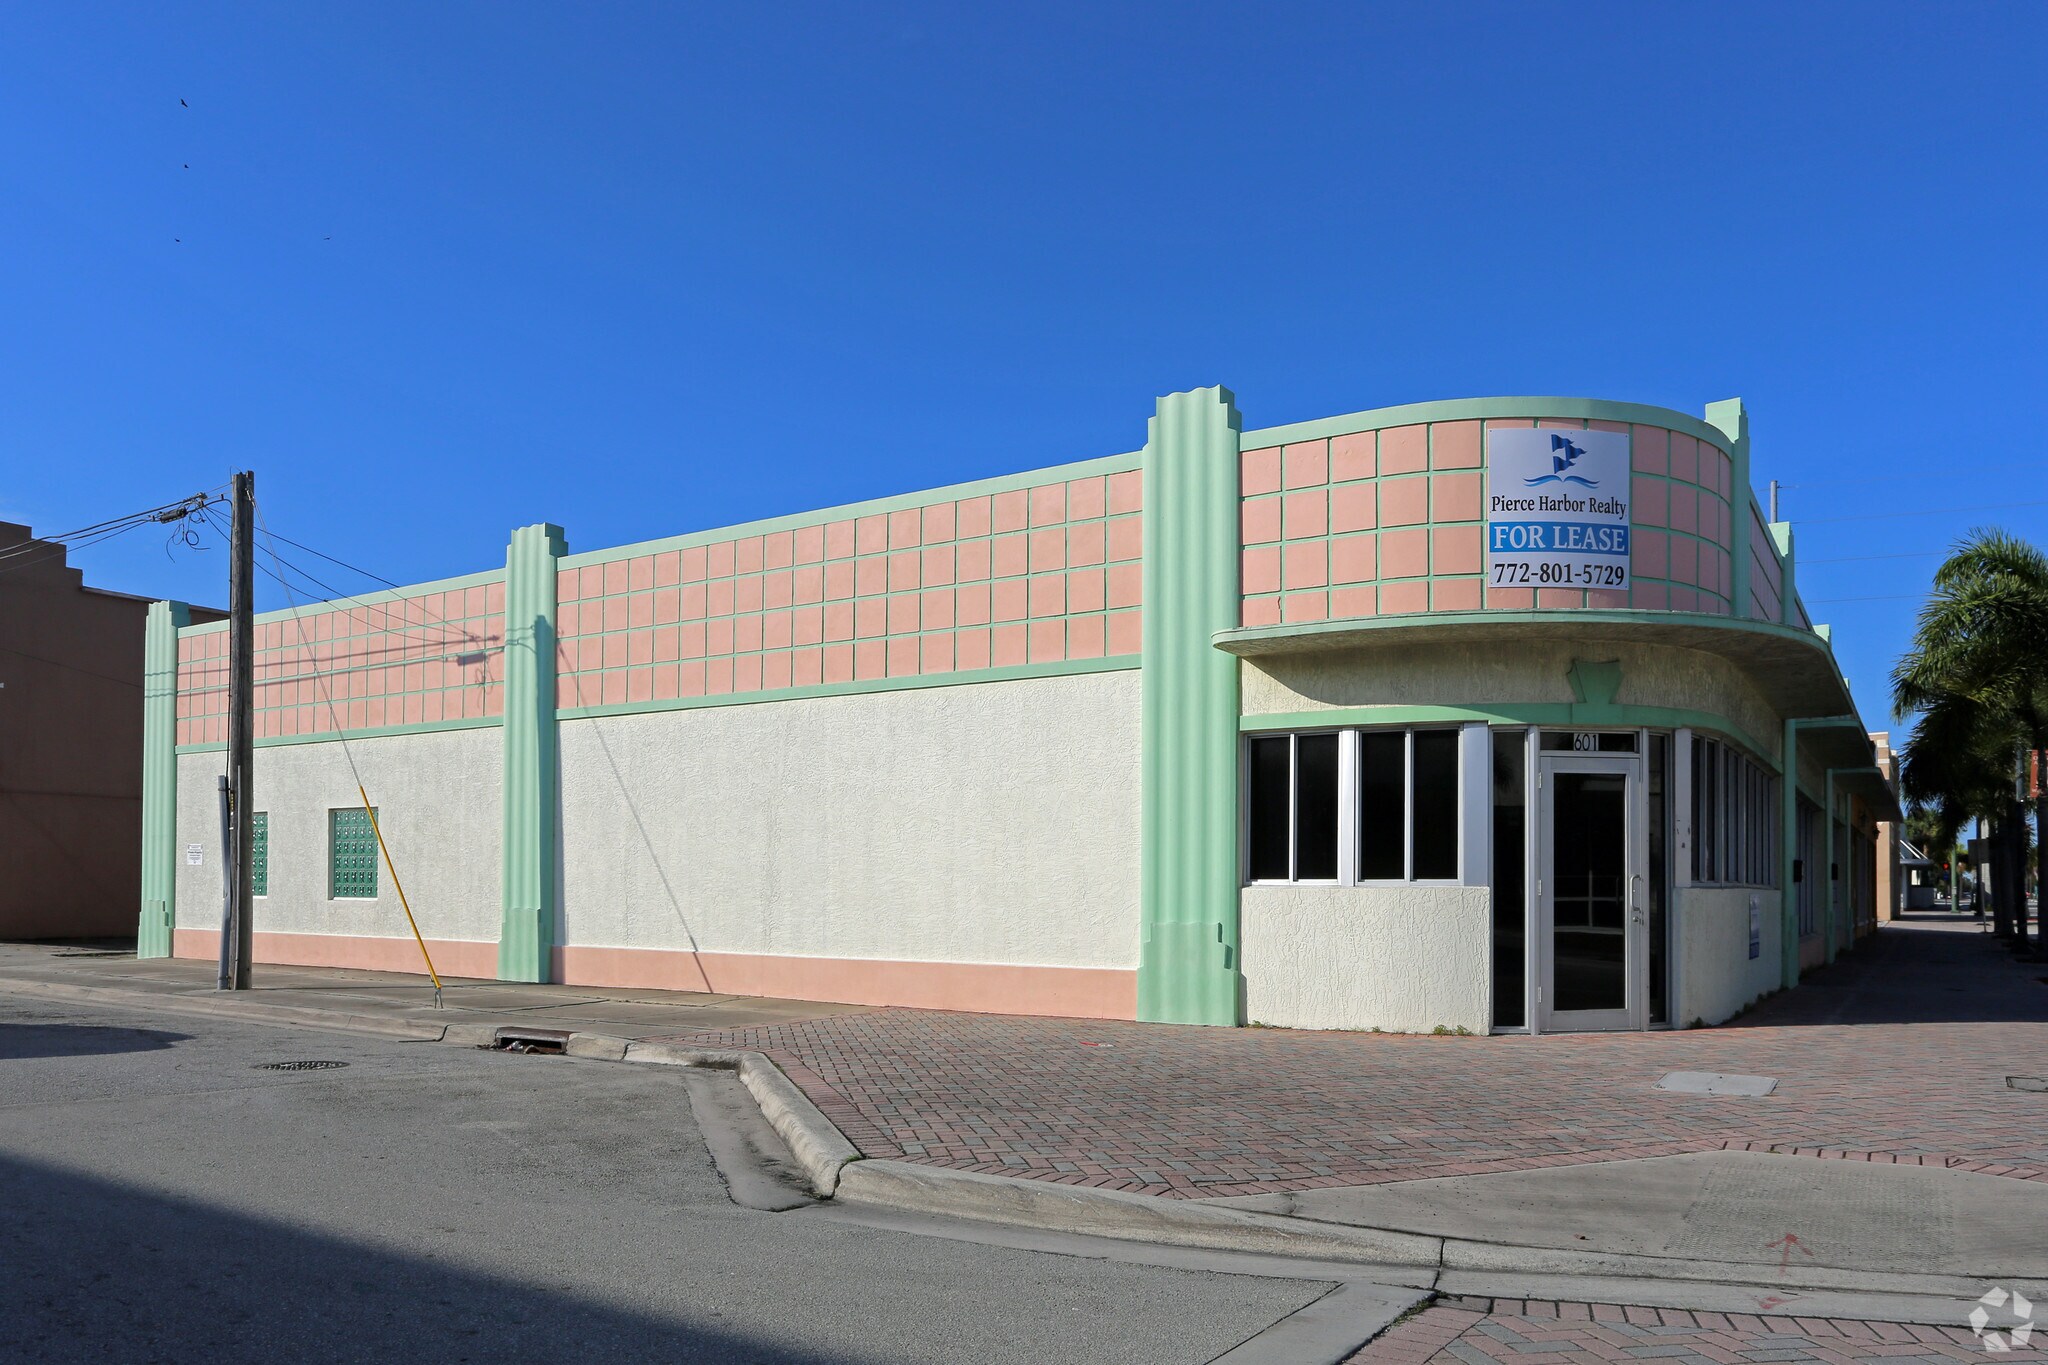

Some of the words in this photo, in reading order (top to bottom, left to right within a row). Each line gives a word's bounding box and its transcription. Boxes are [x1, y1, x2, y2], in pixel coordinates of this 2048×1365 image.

[1491, 495, 1535, 512] Pierce
[1538, 494, 1585, 513] Harbor
[1589, 497, 1627, 520] Realty
[1494, 525, 1545, 549] FOR
[1553, 526, 1625, 552] LEASE
[1494, 563, 1624, 586] 772-801-5729
[1574, 733, 1597, 751] 601
